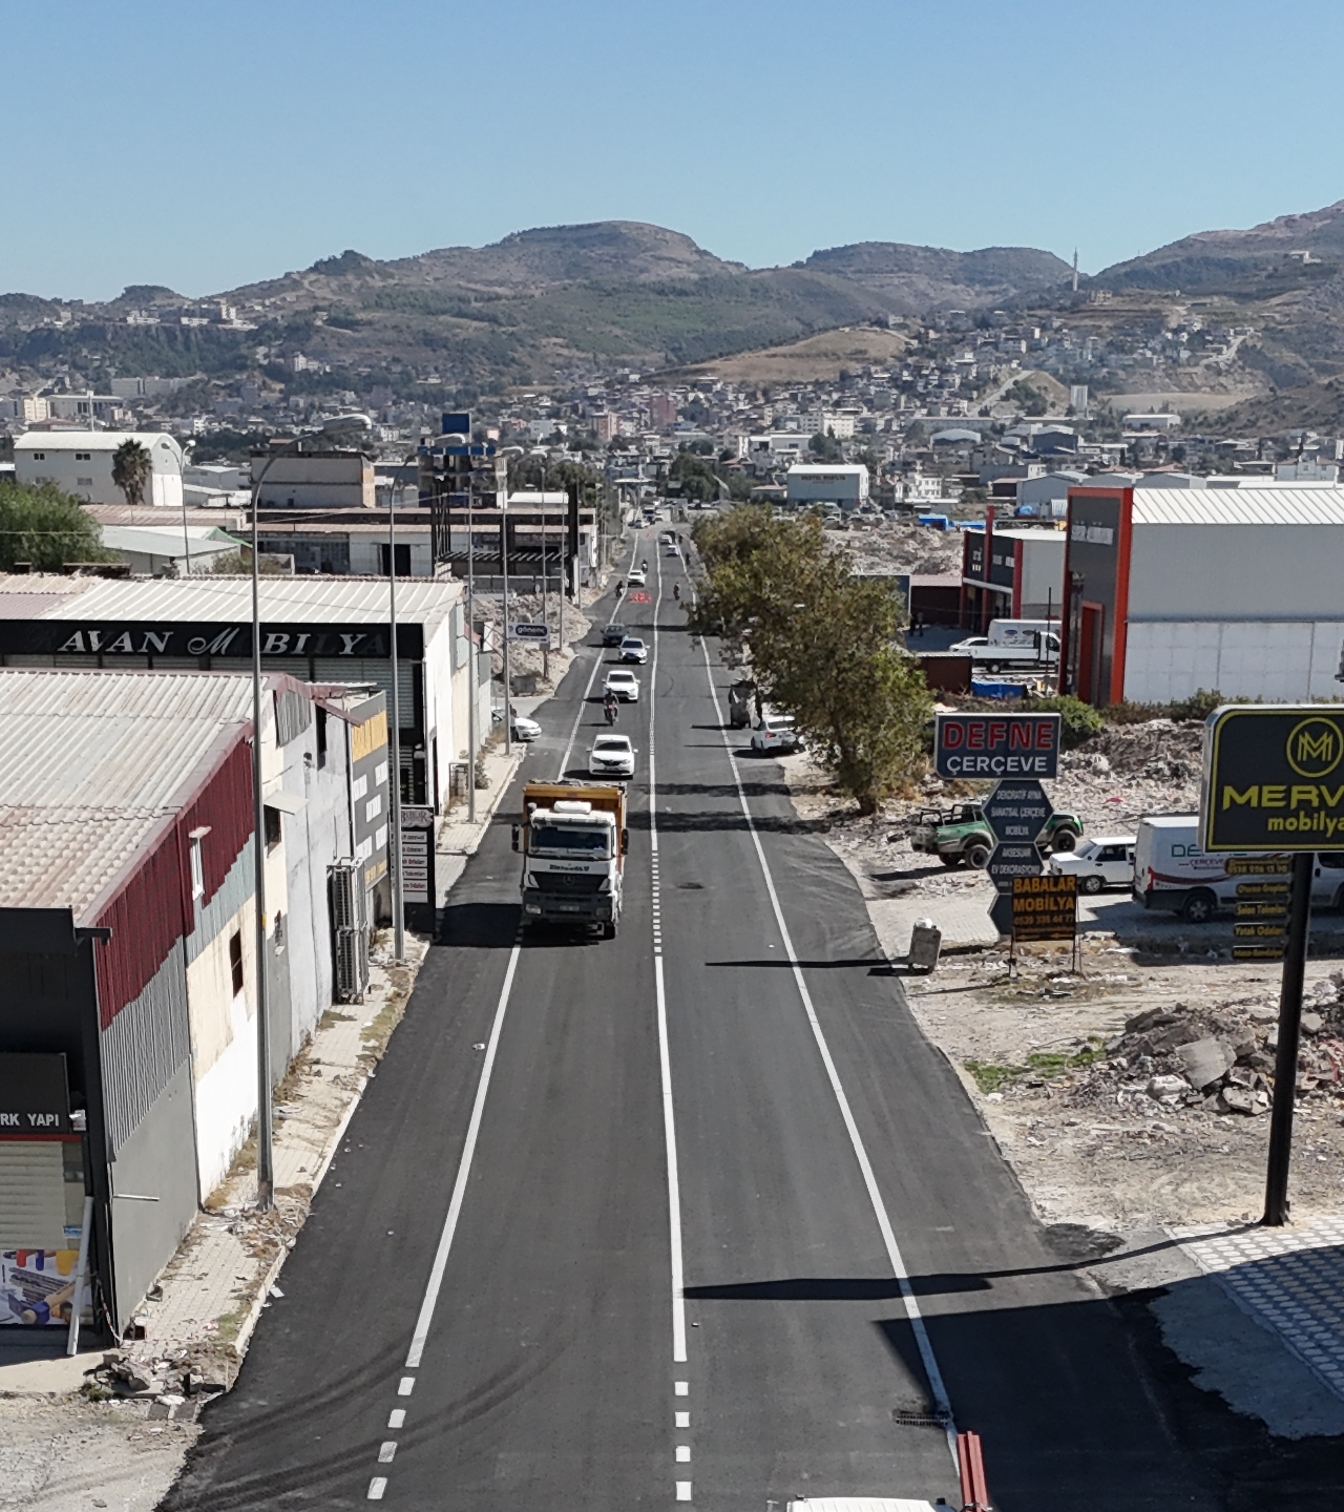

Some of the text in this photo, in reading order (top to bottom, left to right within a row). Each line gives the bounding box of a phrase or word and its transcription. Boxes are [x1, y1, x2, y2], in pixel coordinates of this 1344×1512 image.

[942, 722, 1054, 750] DEFNE
[946, 756, 1048, 776] ÇERÇEVE
[1013, 877, 1075, 893] BABALAR
[1013, 895, 1075, 912] MOBİLYA
[28, 1113, 60, 1128] YAPI
